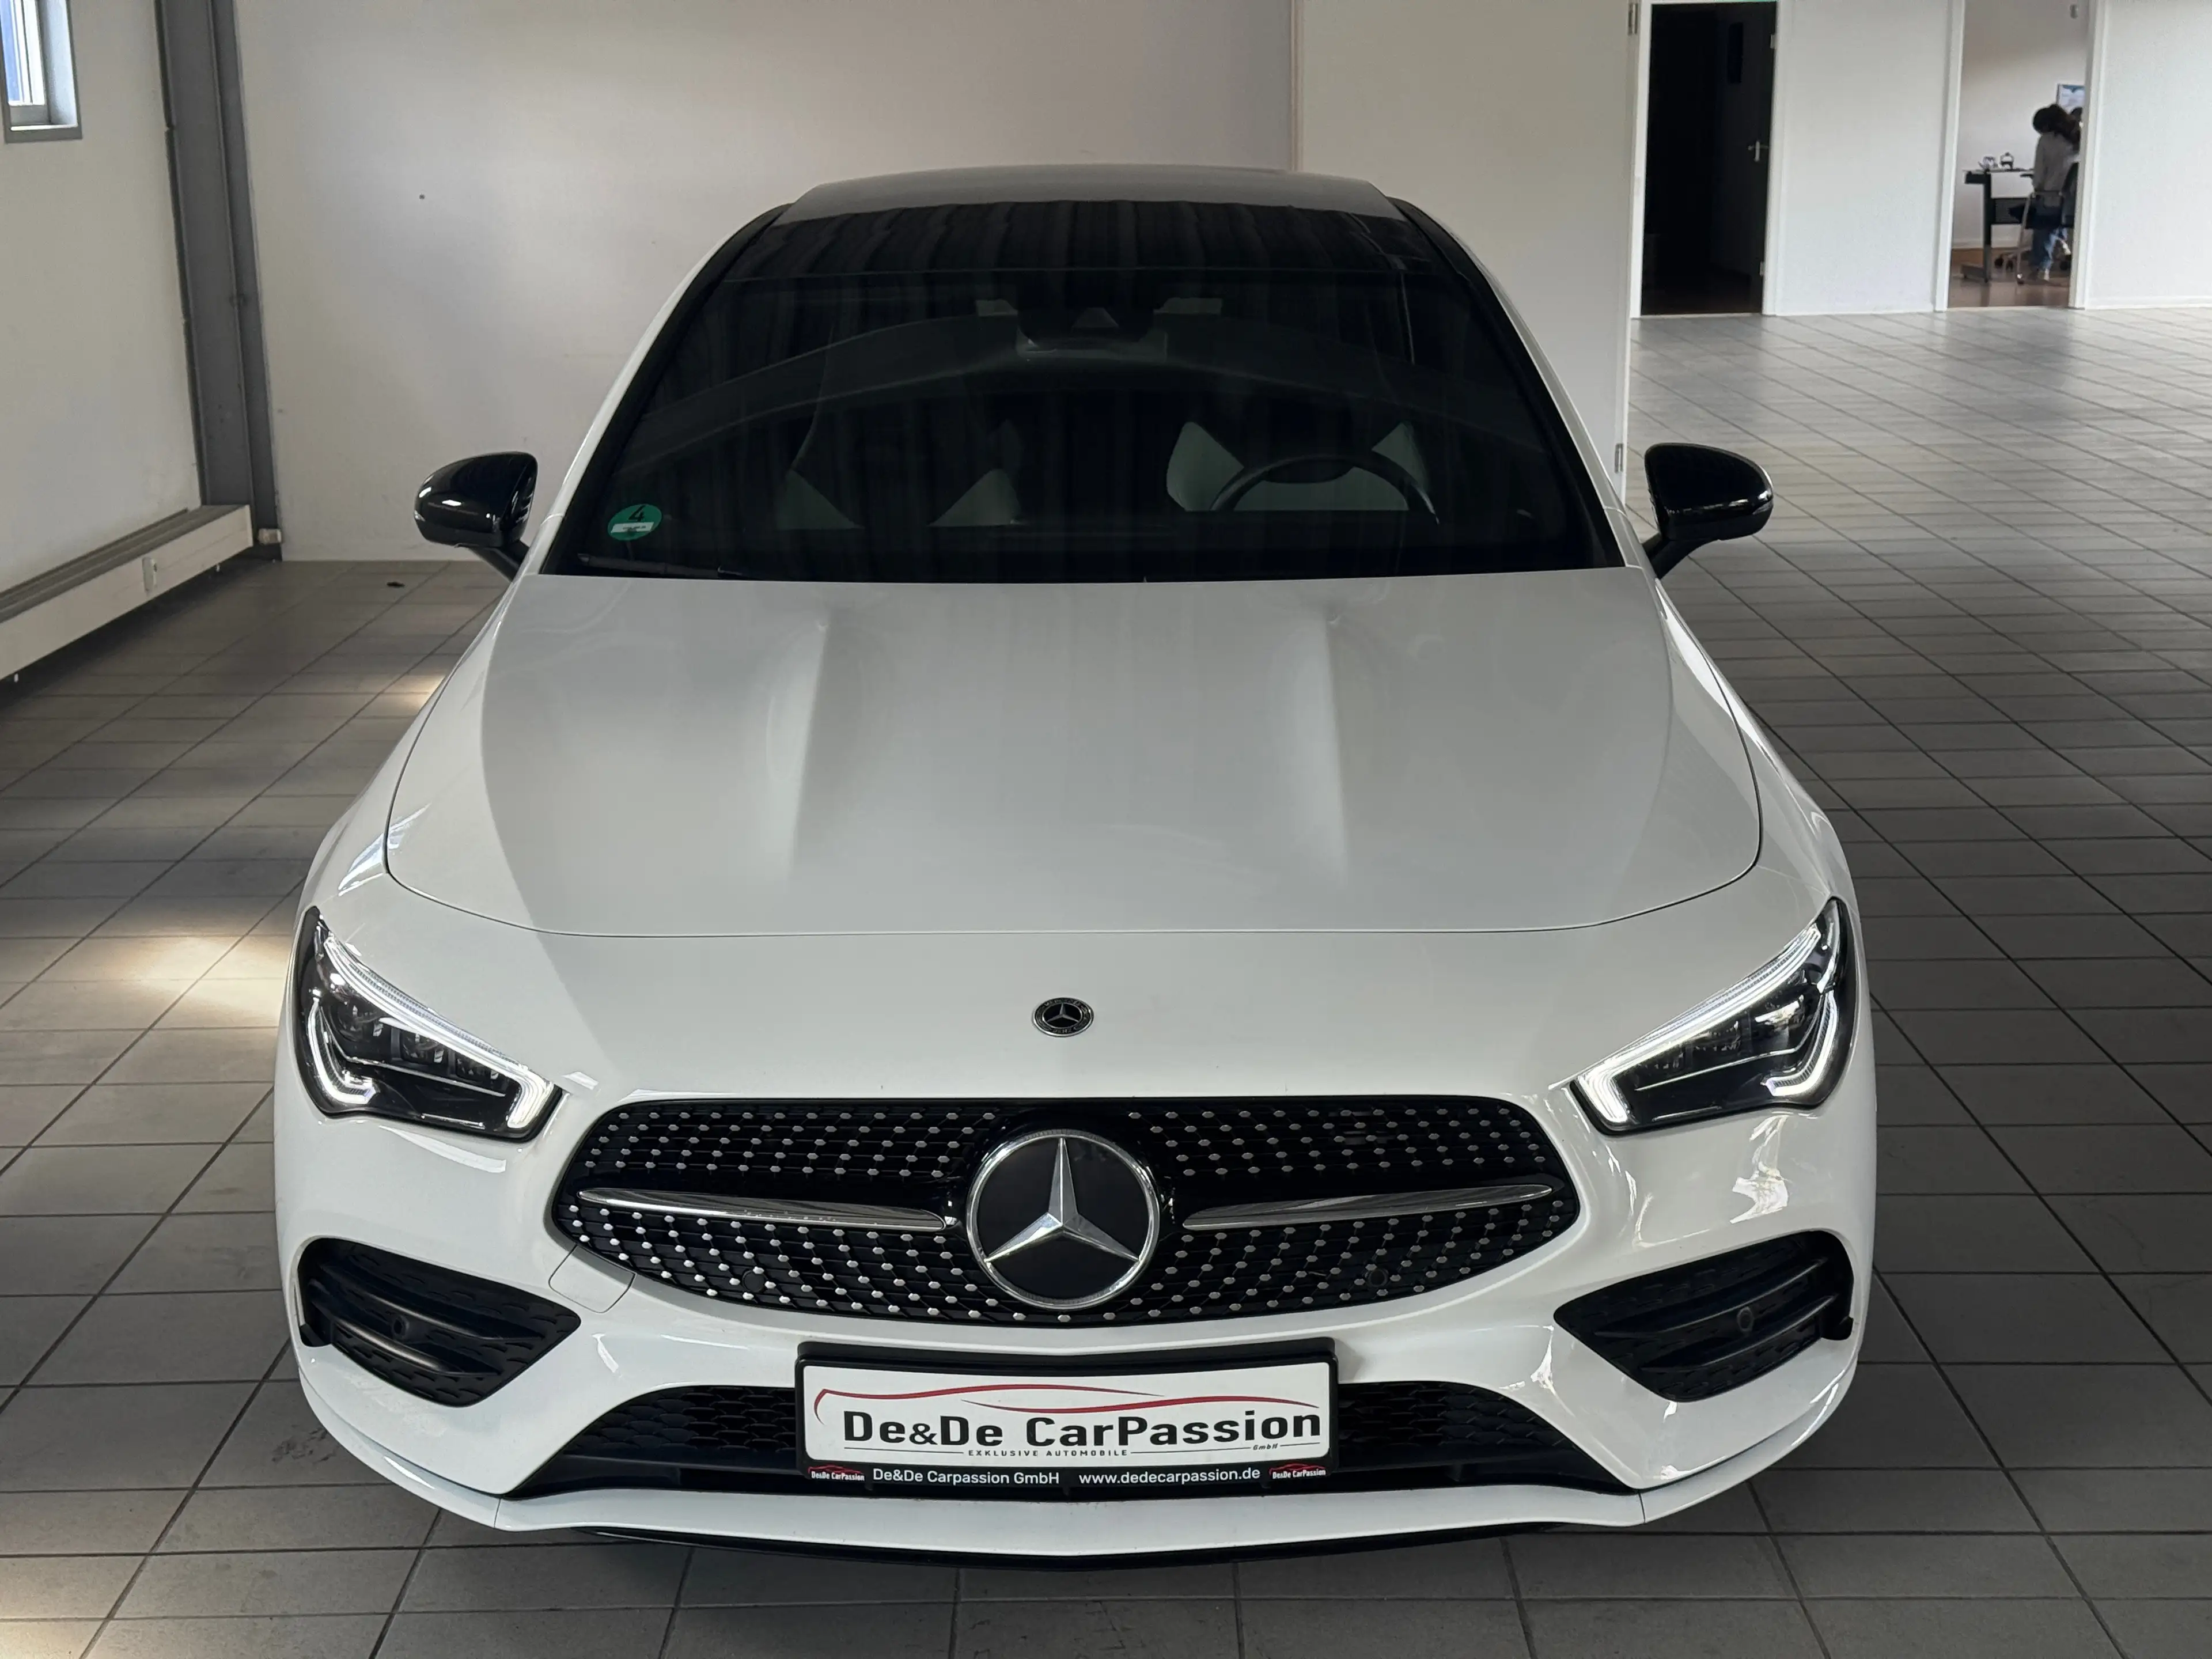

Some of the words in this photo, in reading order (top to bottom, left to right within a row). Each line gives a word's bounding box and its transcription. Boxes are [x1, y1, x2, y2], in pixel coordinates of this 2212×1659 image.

[628, 505, 645, 522] 4
[844, 1410, 1003, 1446] De&De
[1027, 1410, 1320, 1446] CarPassion
[873, 1468, 923, 1482] De&De
[927, 1471, 1010, 1485] Carpassion
[1014, 1472, 1059, 1484] GmbH
[1079, 1467, 1260, 1484] www.dedecarpassion.de
